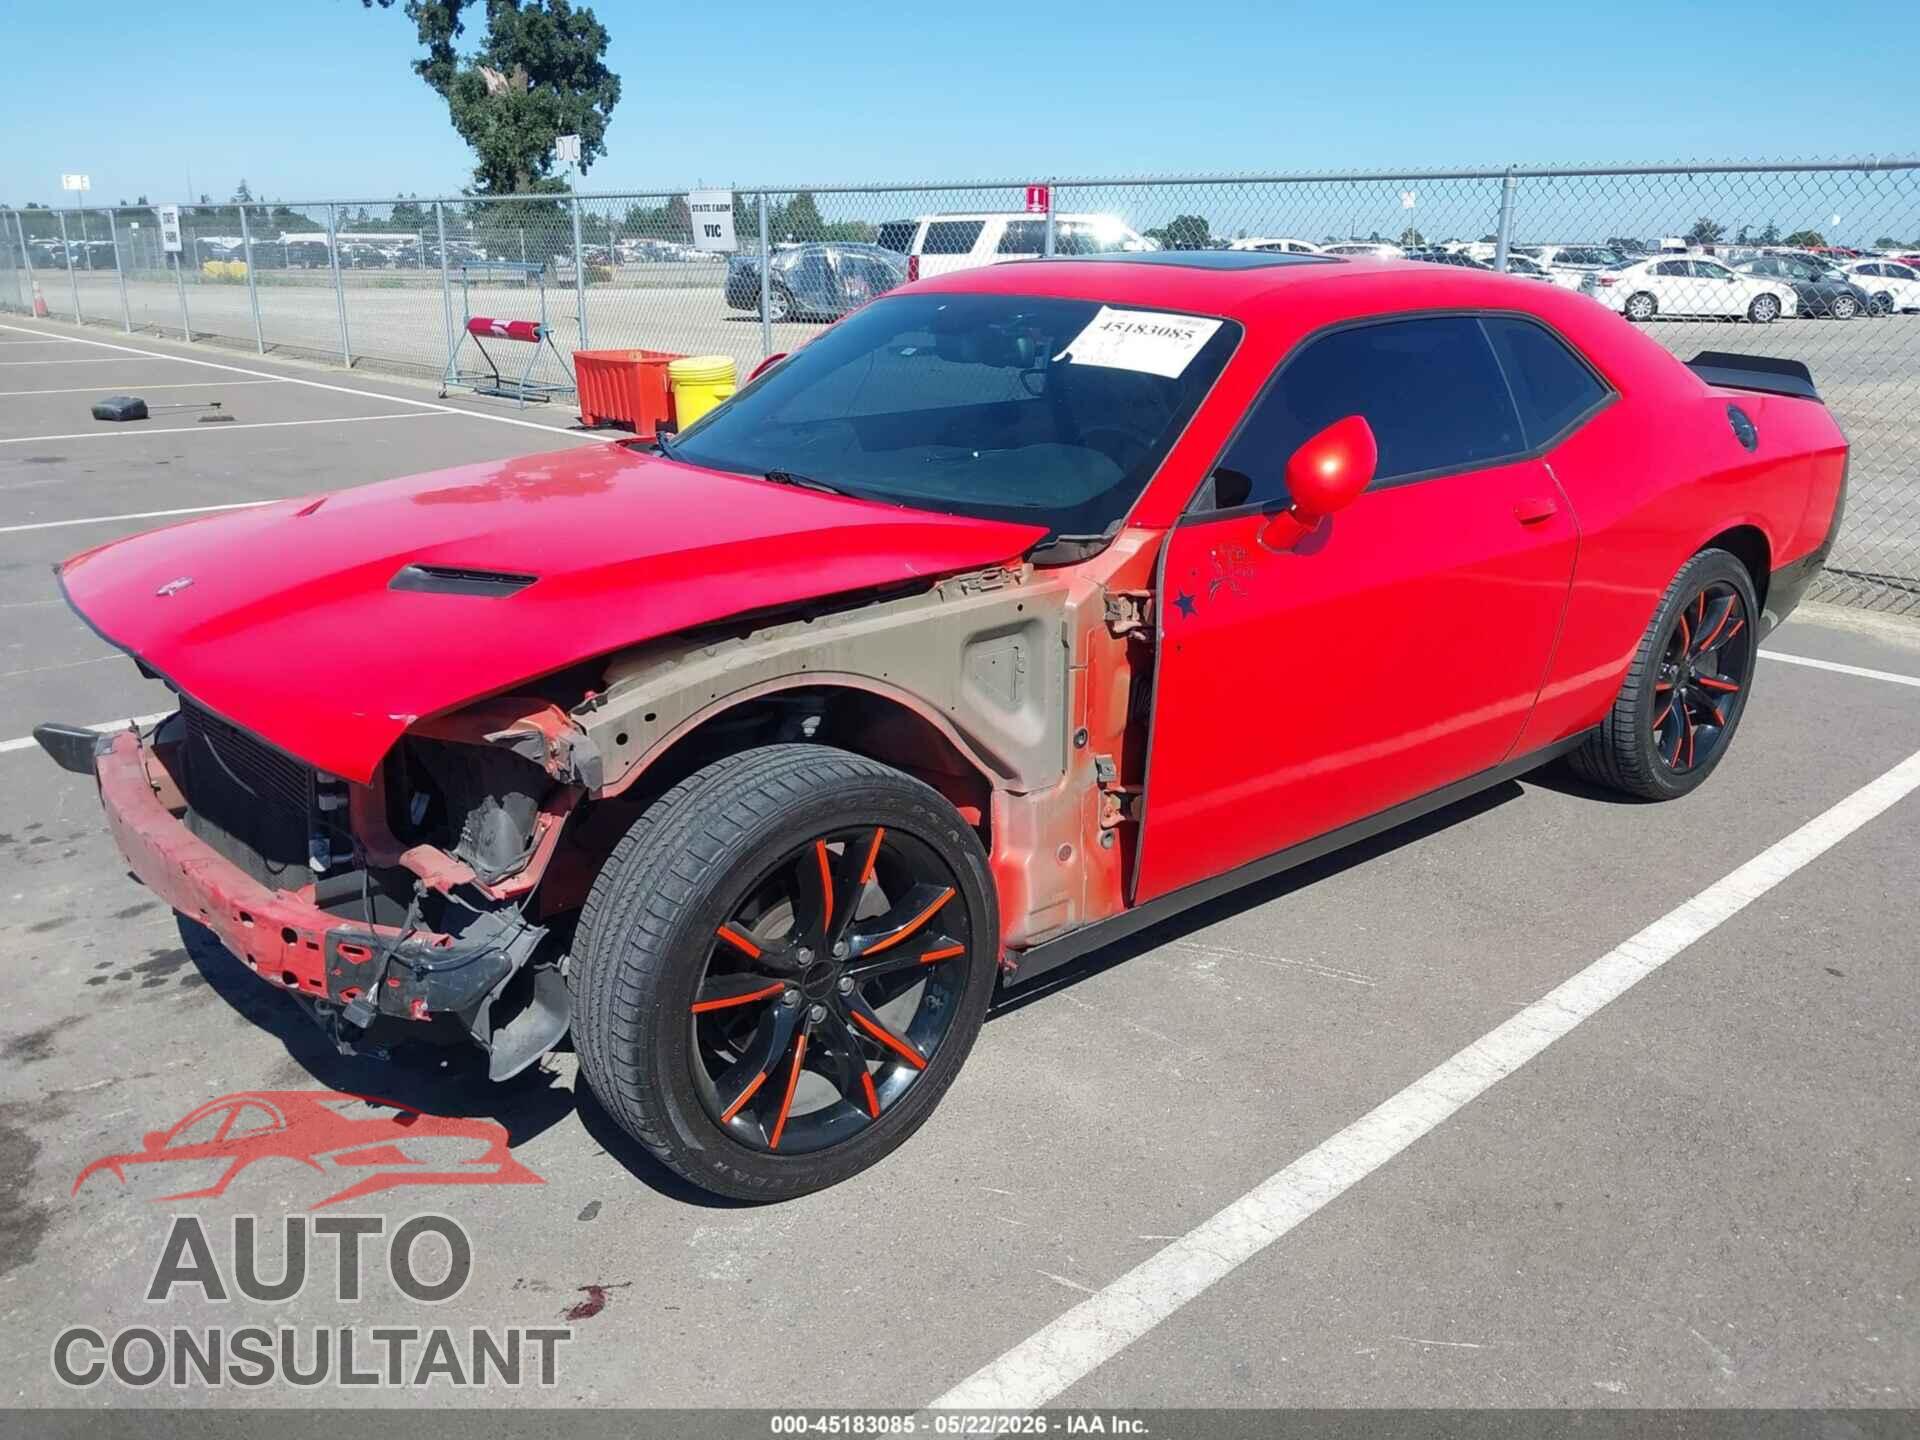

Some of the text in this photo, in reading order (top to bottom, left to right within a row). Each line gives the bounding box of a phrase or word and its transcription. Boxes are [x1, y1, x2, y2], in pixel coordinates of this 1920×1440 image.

[691, 203, 731, 212] STATE FARM
[703, 224, 722, 238] VIC
[1099, 321, 1196, 341] 45183085
